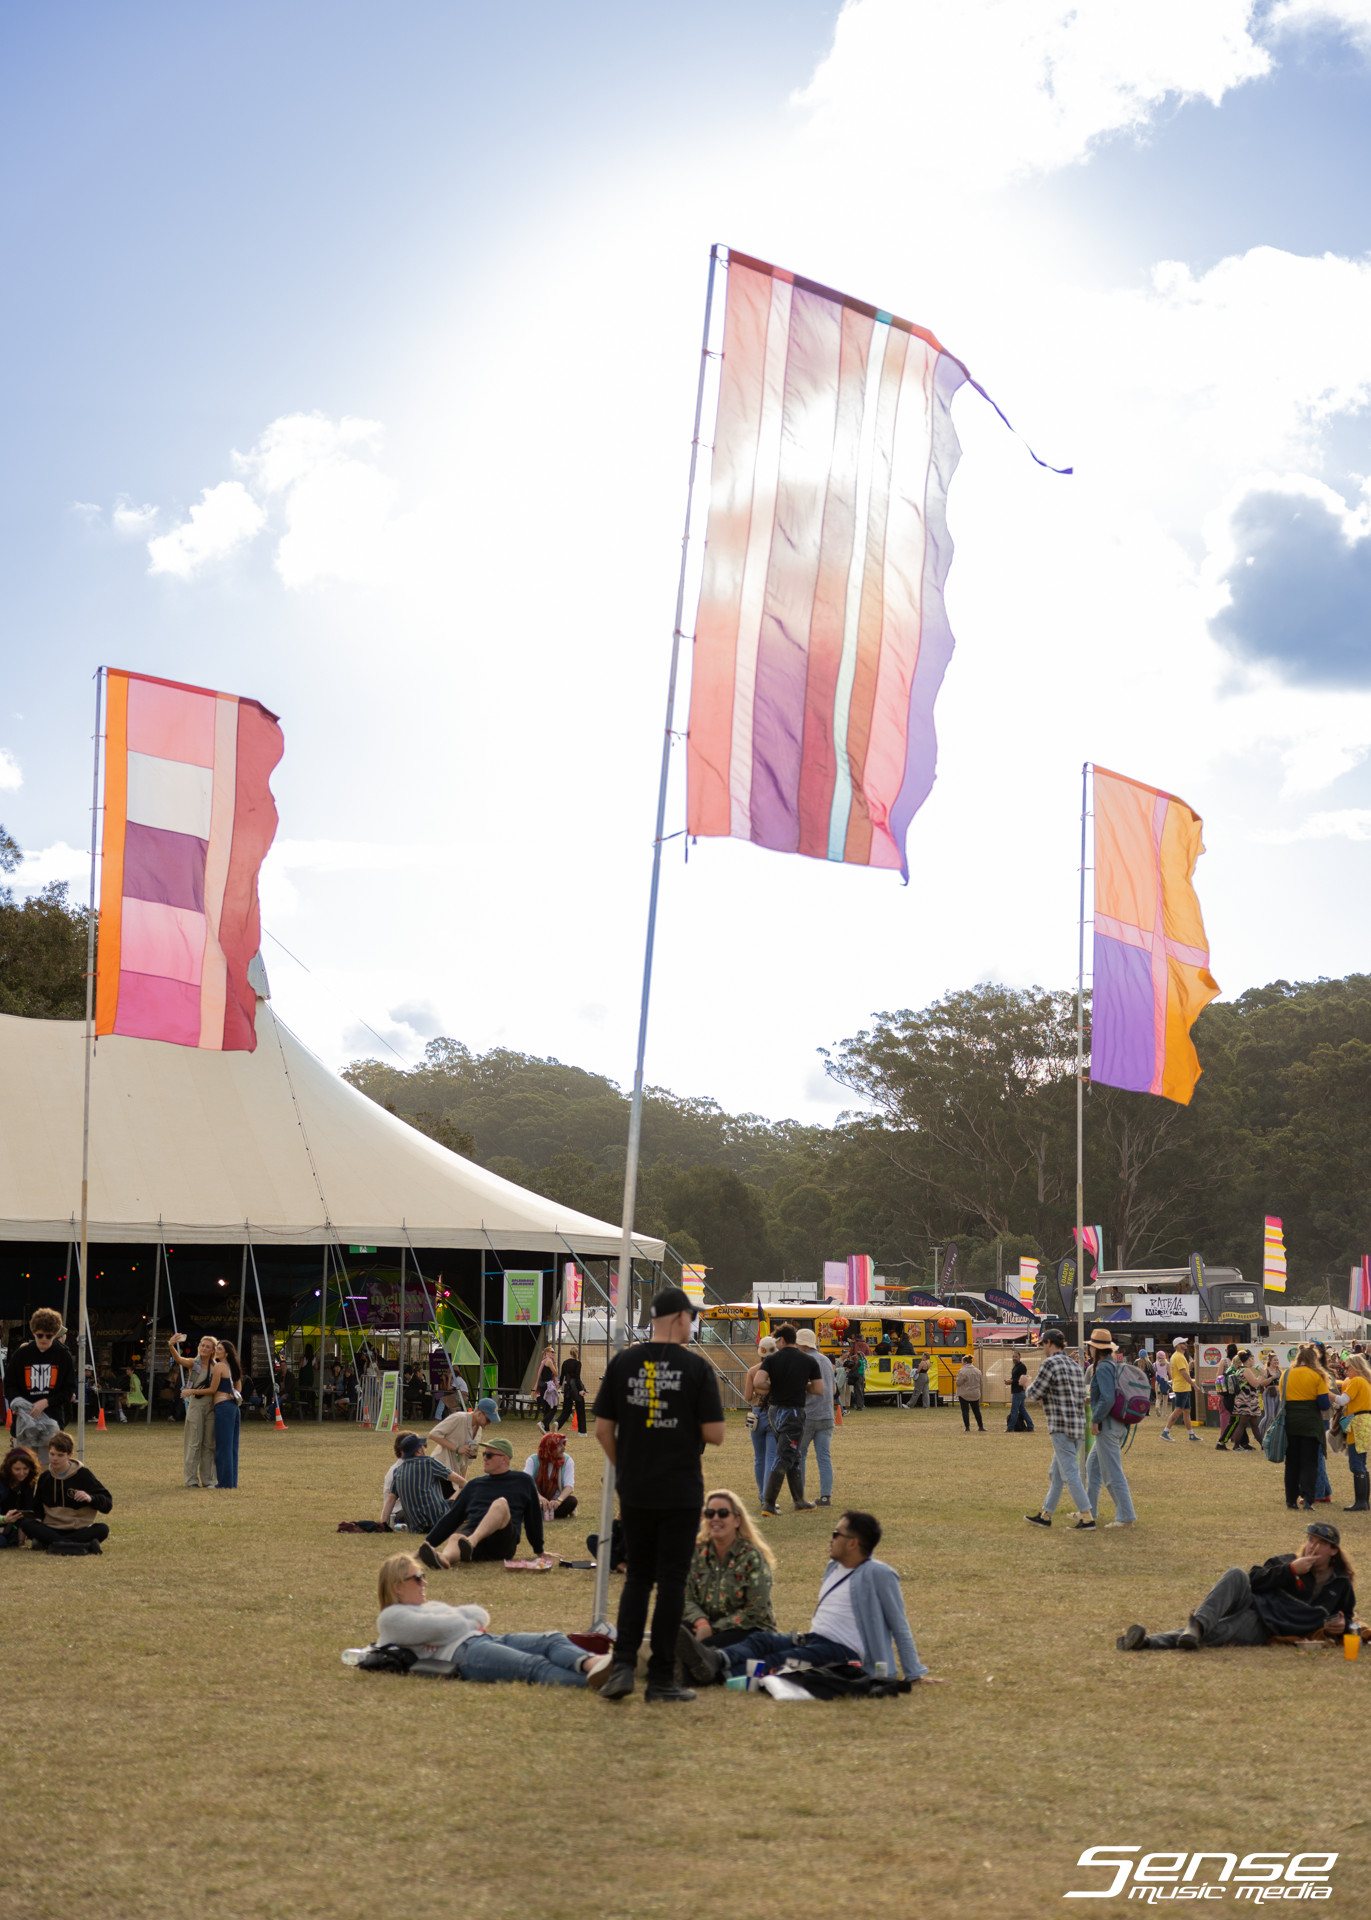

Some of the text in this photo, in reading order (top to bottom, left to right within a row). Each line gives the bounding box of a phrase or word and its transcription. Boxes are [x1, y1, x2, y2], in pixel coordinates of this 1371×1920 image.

[1061, 1262, 1070, 1287] LOADED
[1067, 1267, 1075, 1285] FRIES
[1195, 1256, 1203, 1287] BURGERS
[371, 1292, 432, 1305] mellows
[988, 1293, 1017, 1309] NACHOS
[190, 1315, 239, 1323] TEPPANYAK
[643, 1360, 670, 1370] WHY
[628, 1377, 681, 1390] EVERYONE
[633, 1388, 661, 1398] EXIST
[626, 1395, 669, 1409] TOGETHER
[649, 1409, 662, 1419] IN
[646, 1418, 679, 1428] PEACE?
